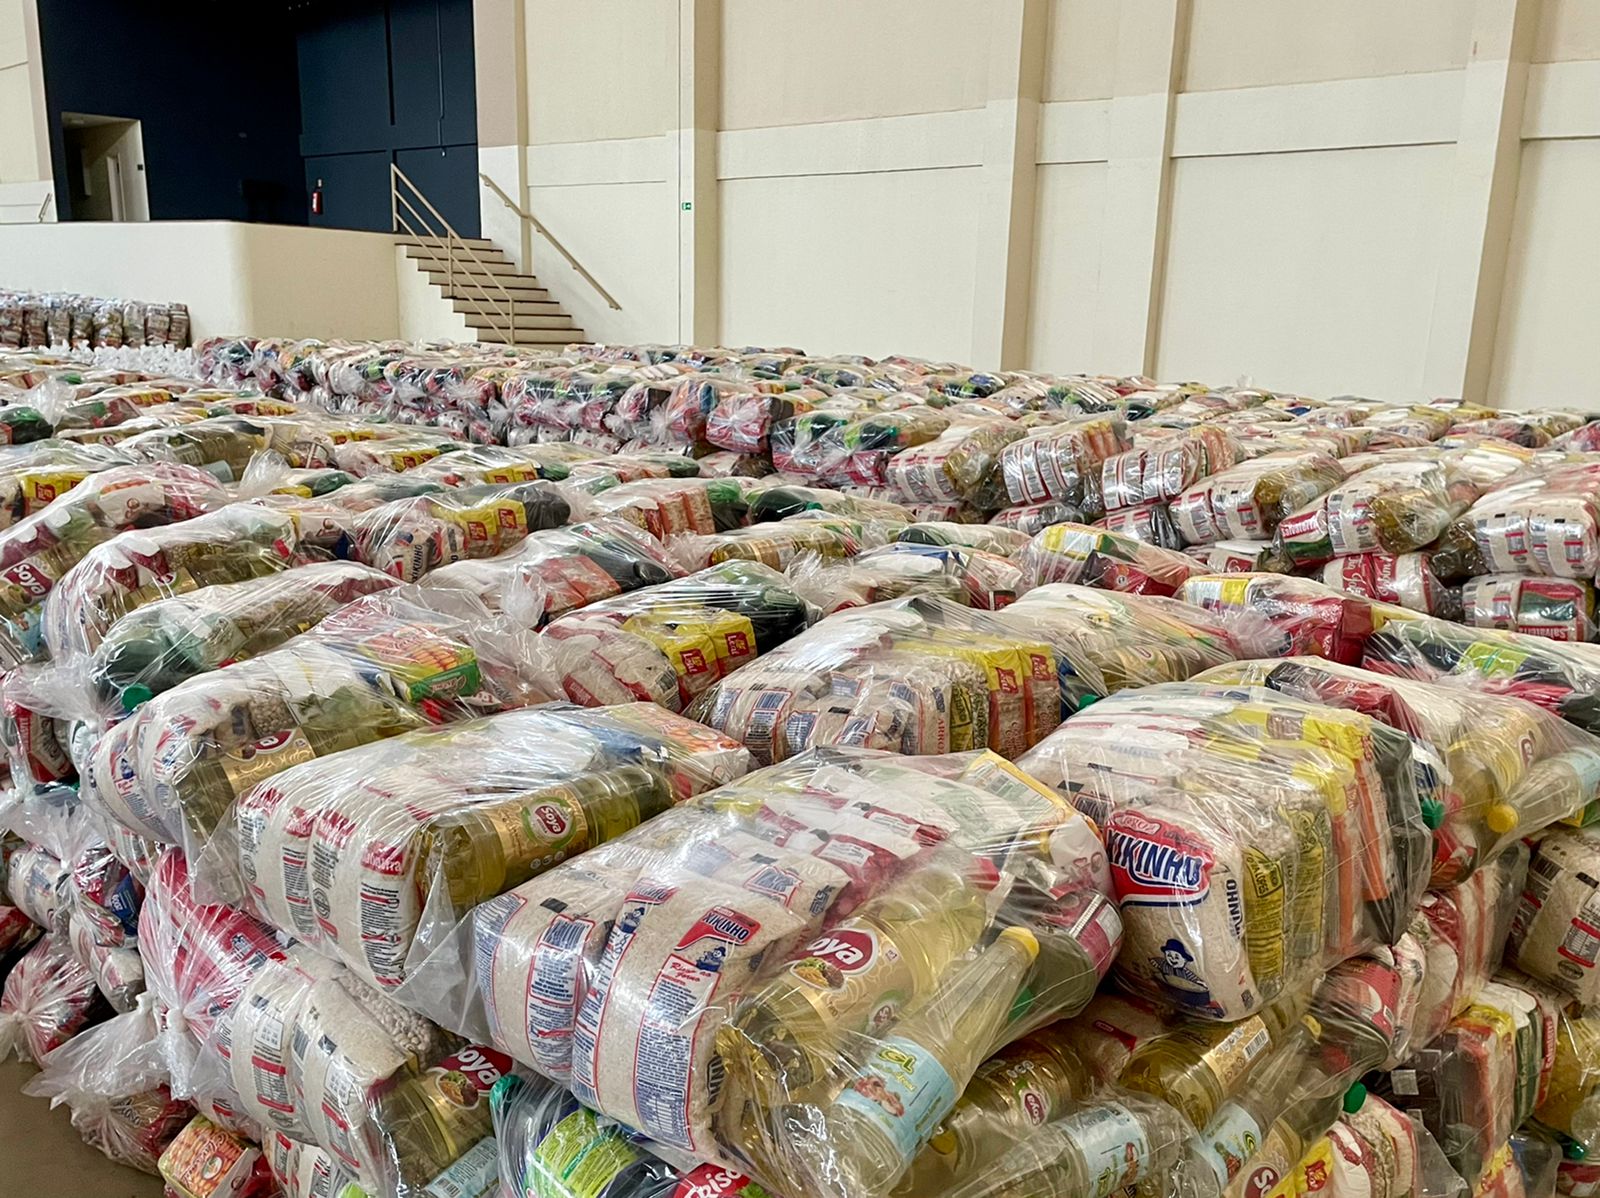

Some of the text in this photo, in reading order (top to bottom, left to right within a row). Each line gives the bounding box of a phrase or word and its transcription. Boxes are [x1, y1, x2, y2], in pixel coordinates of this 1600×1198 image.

[702, 911, 751, 941] XIKINHO
[807, 938, 864, 965] oya
[457, 1049, 501, 1086] oya
